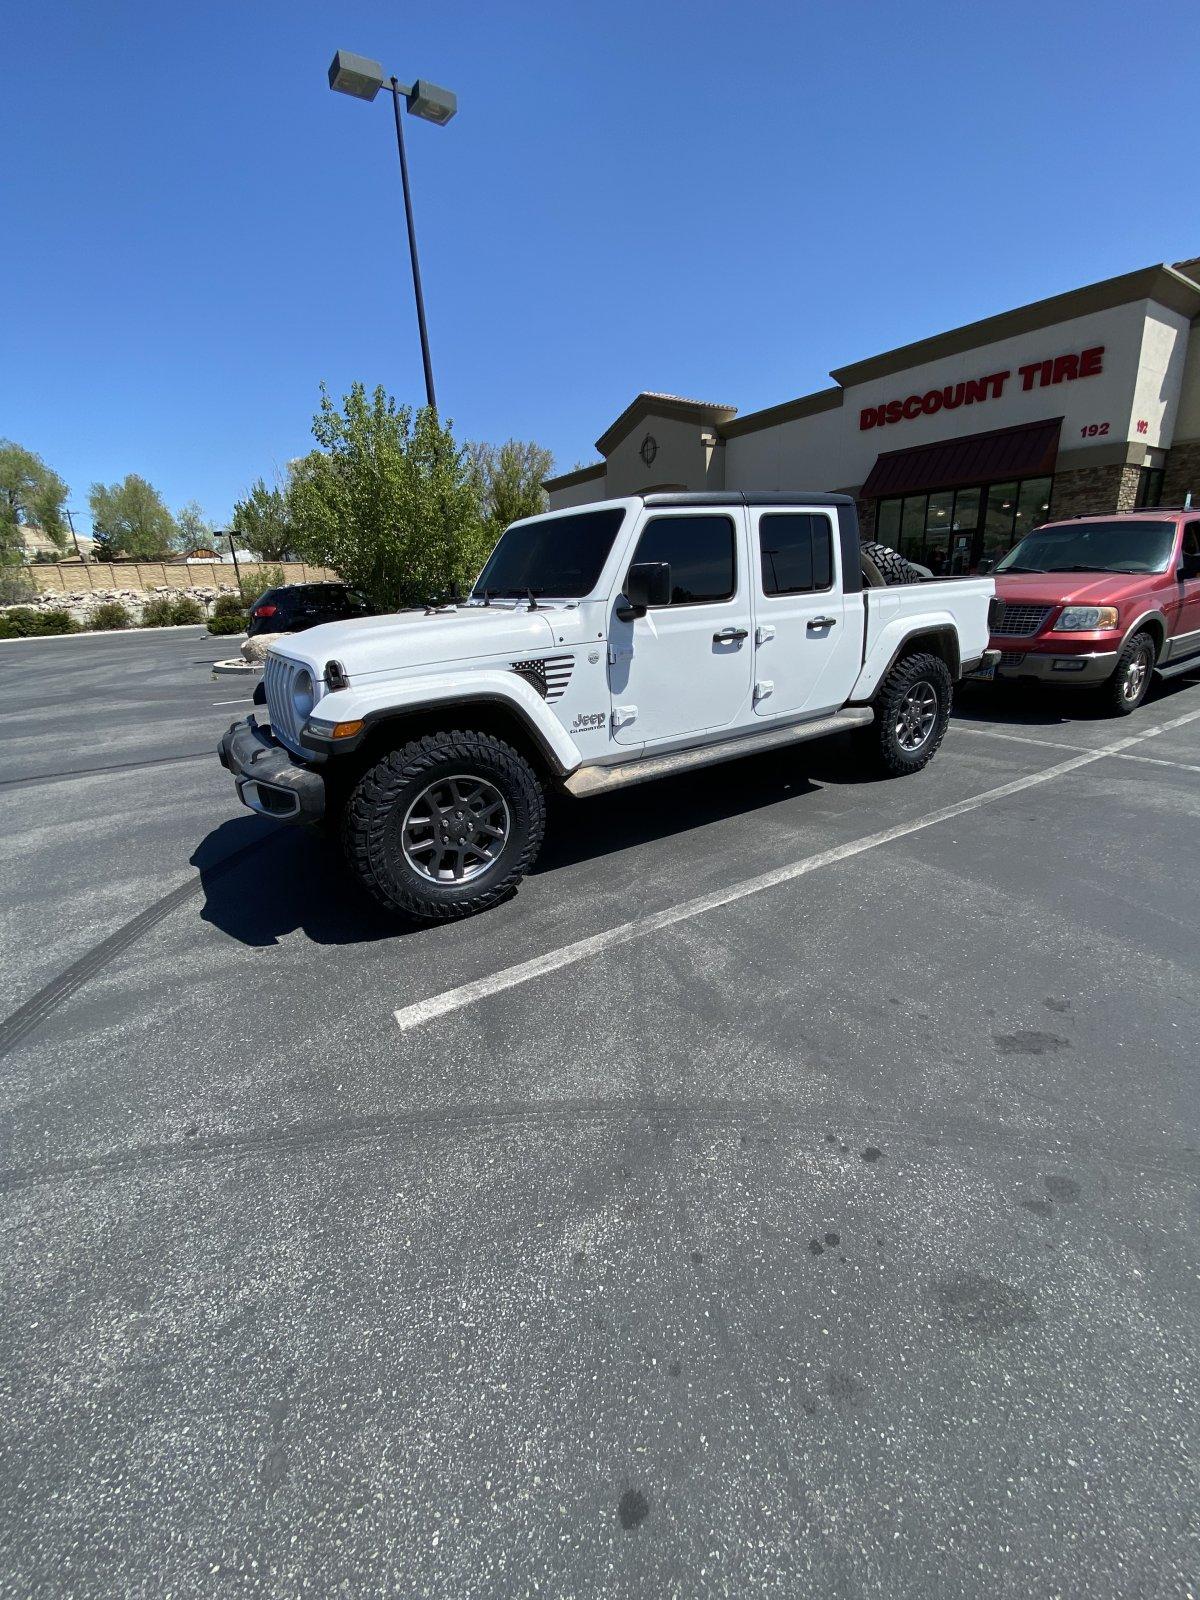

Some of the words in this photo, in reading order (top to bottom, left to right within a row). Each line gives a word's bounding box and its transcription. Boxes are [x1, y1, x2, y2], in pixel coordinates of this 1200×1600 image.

[859, 370, 1011, 431] DISCOUNT
[1018, 346, 1106, 391] TIRE
[1080, 422, 1111, 438] 192
[573, 712, 606, 727] Jeep
